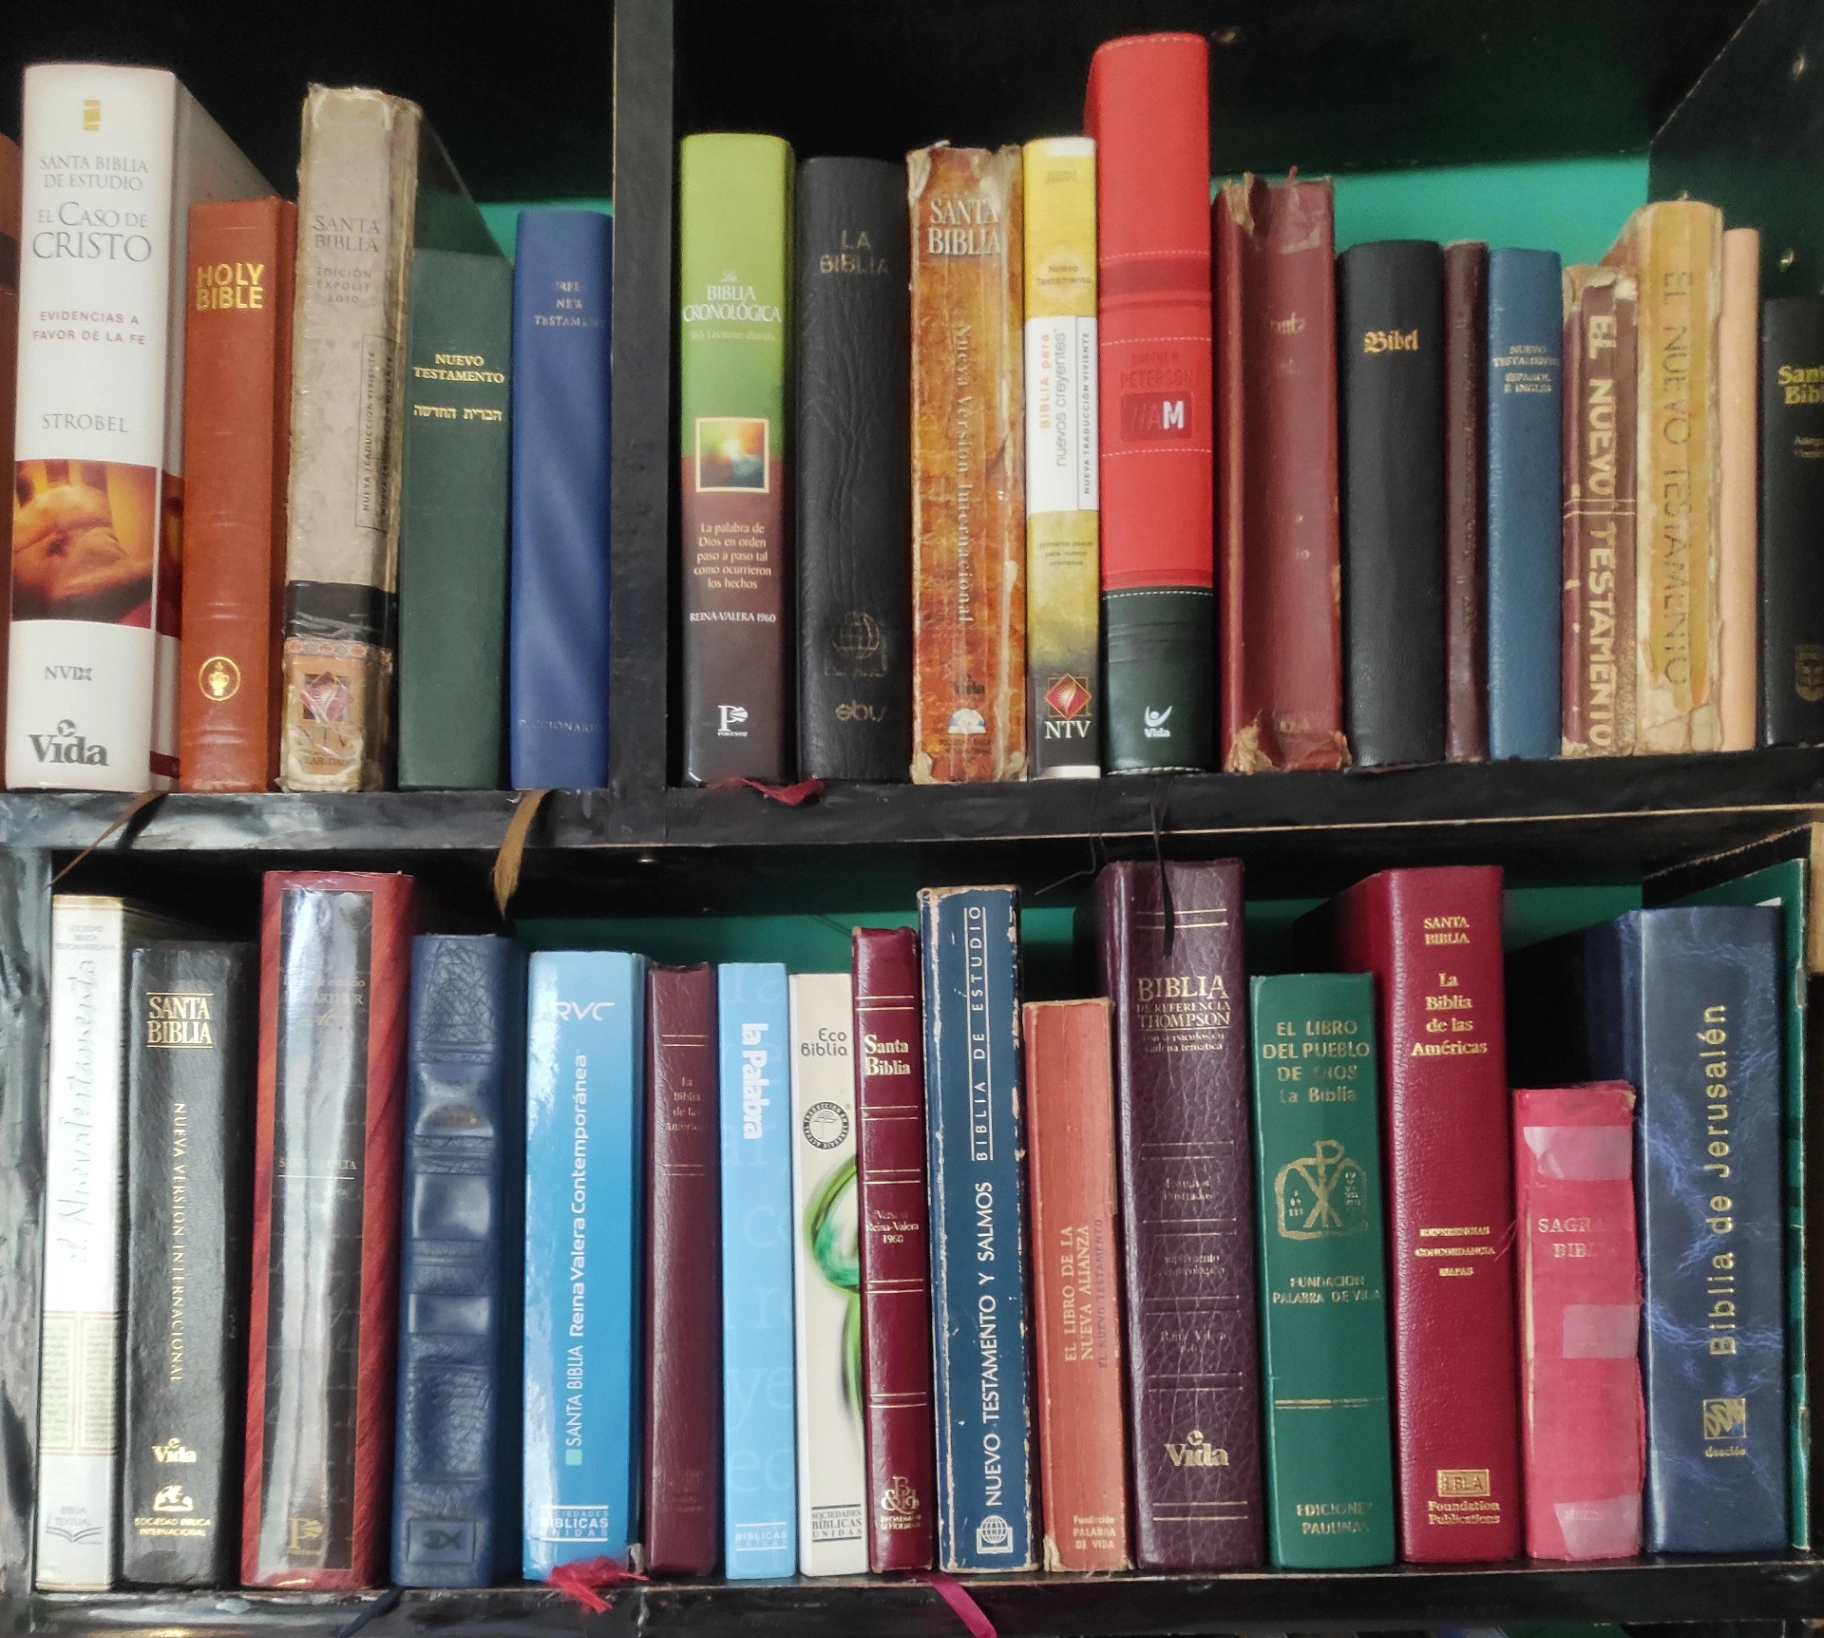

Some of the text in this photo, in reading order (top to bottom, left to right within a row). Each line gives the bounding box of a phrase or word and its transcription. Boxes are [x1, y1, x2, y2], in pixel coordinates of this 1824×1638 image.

[40, 155, 149, 175] SANTA BIBLIA
[44, 173, 144, 191] DE ESTUDIO
[38, 210, 54, 224] EL
[125, 211, 148, 228] DE
[929, 198, 1000, 225] SANTA
[313, 214, 381, 235] SANTA
[32, 231, 152, 262] CRISTO
[314, 234, 379, 253] BIBLIA
[841, 230, 871, 250] LA
[928, 227, 1001, 255] BIBLIA
[820, 253, 889, 275] BIBLIA
[1048, 264, 1079, 273] Nuevo
[196, 263, 264, 287] HOLY
[1036, 277, 1092, 287] Testamento
[196, 286, 264, 310] BIBLE
[707, 284, 757, 302] BIBLIA
[556, 299, 583, 309] NEW
[40, 311, 140, 325] EVIDENCIAS A
[33, 331, 146, 345] FAVOR DE LA FE
[1364, 329, 1419, 354] Bibel
[434, 353, 485, 367] NUEVO
[413, 366, 505, 384] TESTAMENTO
[1040, 333, 1053, 429] BIBLIA para
[1054, 332, 1070, 468] nuevos creyentes
[1082, 332, 1091, 495] NUEVA VIVIENTE
[42, 413, 129, 432] STROBEL
[956, 324, 974, 622] Nueva Internacional
[1663, 271, 1692, 685] EL NUEVO TESTAMENTO
[700, 523, 765, 536] La palabra de
[1588, 314, 1618, 748] EL NUEVO TESTAMENTO
[698, 537, 766, 548] Dios en orden
[696, 550, 768, 564] paso paso tal
[693, 566, 772, 577] como ocurrieron
[707, 578, 758, 589] los hechos
[757, 612, 777, 623] 1960
[1045, 720, 1091, 739] NTV
[1144, 727, 1172, 738] Vida
[29, 734, 110, 766] Vida
[1424, 916, 1470, 929] SANTA
[1424, 932, 1470, 945] BIBLIA
[1137, 975, 1230, 1001] BIBLIA
[1439, 973, 1458, 987] La
[149, 997, 211, 1019] SANTA
[553, 1001, 616, 1021] RVC
[1137, 1001, 1231, 1013] DE REFERENCIA
[1426, 995, 1472, 1010] Biblia
[1138, 1011, 1230, 1029] THOMPSON
[1276, 1020, 1358, 1037] EL LIBRO
[1426, 1017, 1473, 1033] de las
[147, 1020, 213, 1044] BIBLIA
[818, 1027, 847, 1042] Eco
[968, 906, 988, 1161] BIBLIA DE ESTUDIO
[801, 1042, 848, 1057] Biblia
[864, 1034, 909, 1053] Santa
[1262, 1042, 1370, 1060] DEL PUEBLO
[1411, 1040, 1488, 1056] Américas
[864, 1056, 911, 1076] Biblia
[1277, 1066, 1302, 1081] DE
[741, 1022, 770, 1139] la Palabra
[1279, 1086, 1356, 1103] La Biblia
[672, 1106, 686, 1117] de
[173, 1102, 187, 1157] NUEVA
[1697, 1005, 1737, 1356] Biblia de Jerusalén
[1420, 1225, 1490, 1237] REFERENCIAS
[565, 1054, 589, 1447] SANTA BIBLIA Reina Valera Contemporánea
[1415, 1246, 1496, 1256] CONCORDANCIA
[1093, 1219, 1105, 1302] TESTAMENTO
[1439, 1267, 1474, 1276] MAPAS
[1059, 1225, 1077, 1363] EL LIBRO DE LA
[1076, 1225, 1094, 1361] NUEVA ALIANZA
[1273, 1291, 1325, 1304] PALABRA
[1331, 1289, 1349, 1303] DE
[170, 1244, 185, 1381] INTERNACIONAL
[975, 1182, 1002, 1507] NUEVO TESTAMENTO Y SALMOS
[152, 1445, 197, 1462] Vida
[1164, 1444, 1229, 1467] Vida
[1443, 1475, 1485, 1491] LBLA
[1296, 1502, 1372, 1516] EDICIONES
[1428, 1500, 1500, 1511] Foundation
[134, 1517, 178, 1526] SOCIEDAD
[811, 1510, 862, 1521] SOCIEDADES
[1428, 1513, 1501, 1525] Publications
[139, 1528, 207, 1537] INTERNACIONAL
[811, 1528, 862, 1539] UNIDAS
[1073, 1528, 1116, 1538] PALABRA
[1302, 1521, 1370, 1535] PAULINAS
[1075, 1539, 1115, 1549] DE VIDA
